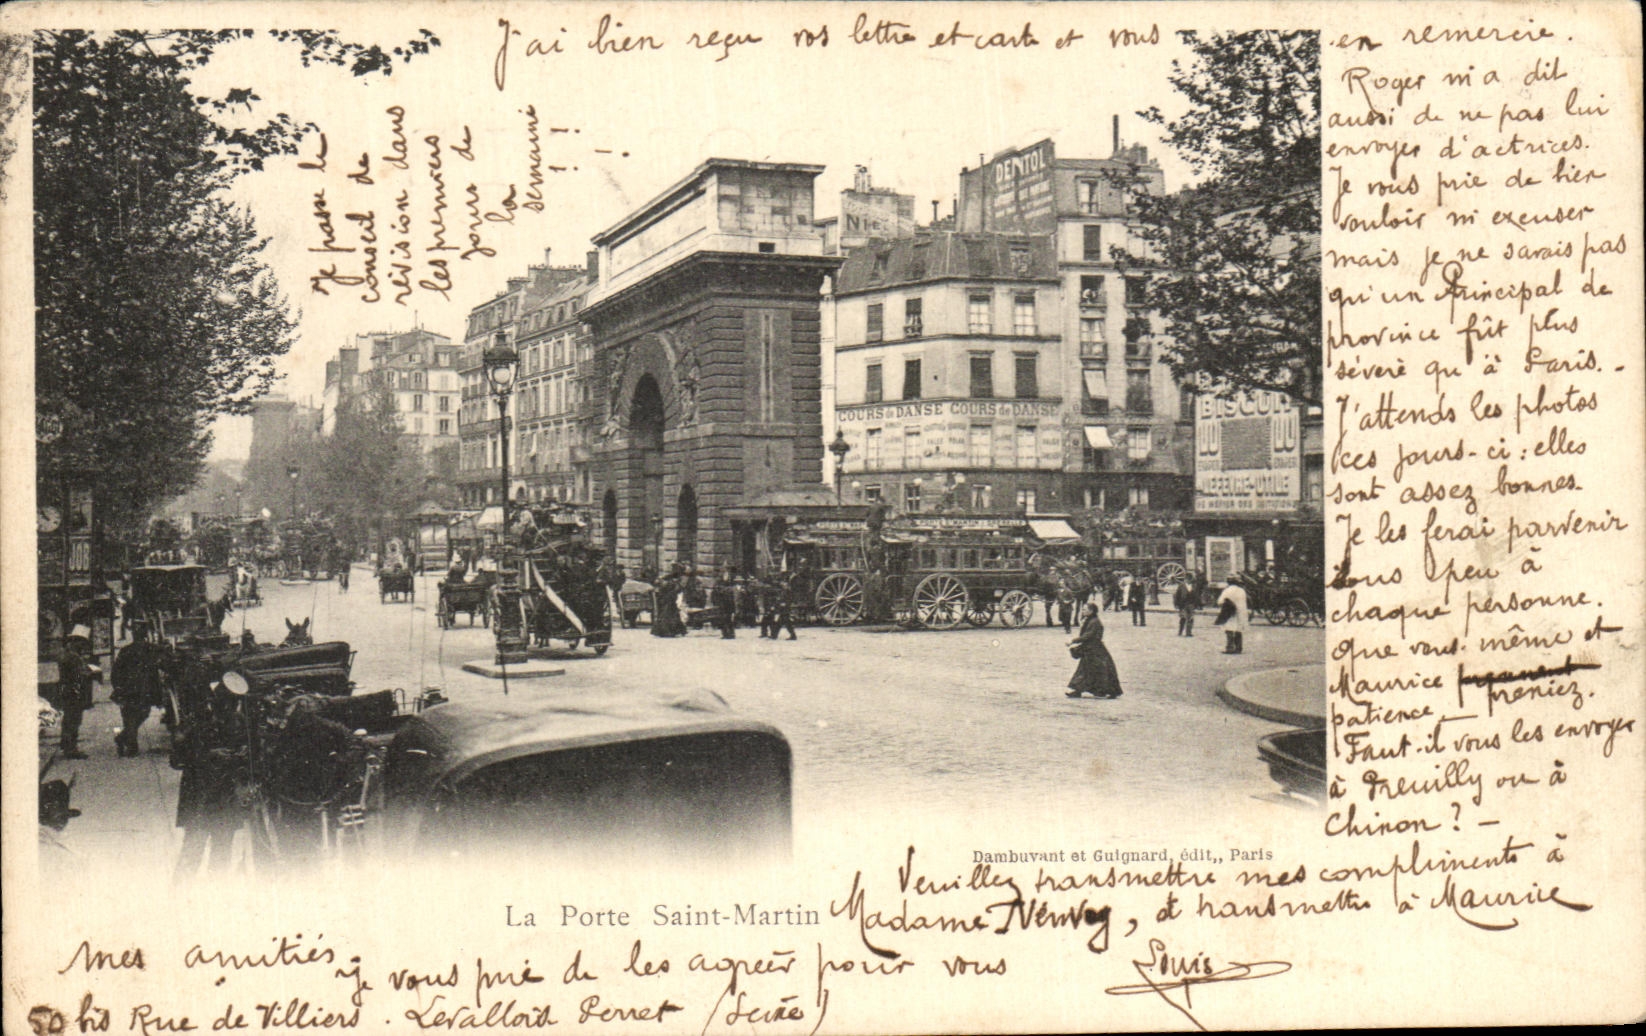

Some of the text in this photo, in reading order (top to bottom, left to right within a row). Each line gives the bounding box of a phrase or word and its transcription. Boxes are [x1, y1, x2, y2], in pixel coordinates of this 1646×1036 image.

[494, 18, 564, 91] J'ai
[588, 14, 663, 54] bien
[687, 29, 763, 62] reçu
[794, 25, 829, 47] vos
[928, 21, 972, 48] et
[1056, 29, 1083, 49] et
[1109, 23, 1159, 48] vous
[1335, 33, 1382, 51] en
[1341, 67, 1426, 110] Roger
[1524, 57, 1568, 86] dit
[1328, 87, 1609, 133] aussi de ne pas lui
[297, 133, 328, 172] le
[383, 105, 410, 170] dans
[1325, 139, 1420, 179] envoyer
[995, 148, 1046, 184] DENTOL
[1368, 173, 1418, 195] vous
[1438, 171, 1487, 206] prie
[1506, 168, 1541, 188] de
[1552, 157, 1607, 183] bien
[450, 125, 497, 260] jours de
[484, 183, 518, 225] la
[308, 188, 356, 252] passe
[345, 152, 380, 303] conseil de
[419, 135, 460, 301] les premiers
[1339, 202, 1426, 232] vouloir
[1326, 249, 1399, 268] mais
[1457, 247, 1489, 262] ne
[1581, 232, 1627, 273] pas
[1582, 268, 1613, 296] de
[1326, 320, 1440, 368] province
[1529, 307, 1578, 350] plus
[838, 408, 884, 421] COURS
[896, 403, 943, 419] DANSE
[950, 402, 997, 416] COURS
[1012, 402, 1058, 416] DANSE
[1471, 390, 1502, 421] les
[1517, 384, 1598, 434] photos
[1341, 450, 1376, 470] ces
[1534, 426, 1587, 456] elles
[1326, 475, 1385, 504] sont
[1400, 481, 1476, 514] assez
[1375, 510, 1406, 544] les
[1422, 506, 1496, 581] ferai
[1509, 509, 1628, 553] parvenir
[1443, 558, 1499, 604] peu
[1521, 547, 1542, 575] à
[1331, 590, 1450, 639] chaque
[1584, 616, 1623, 641] et
[1330, 665, 1443, 706] Maurice
[1454, 733, 1500, 750] vous
[1511, 718, 1544, 742] les
[1555, 717, 1636, 757] envoyer
[1330, 775, 1346, 799] à
[1496, 776, 1540, 788] ou
[1550, 759, 1566, 785] à
[899, 833, 1566, 907] Veuillez transmettre mes compliments à
[830, 871, 991, 958] Madame
[1398, 895, 1415, 914] à
[1430, 876, 1593, 931] Maurice
[389, 963, 458, 990] vous
[476, 958, 543, 1008] prie
[563, 950, 598, 984] de
[623, 939, 670, 977] les
[816, 942, 915, 1008] pour
[943, 955, 1006, 977] vous
[75, 993, 110, 1033] bis
[128, 1004, 198, 1036] Rue
[212, 1004, 249, 1030] de
[256, 998, 360, 1029] Villiers
[405, 995, 559, 1030] Levallois
[578, 995, 684, 1024] Perret
